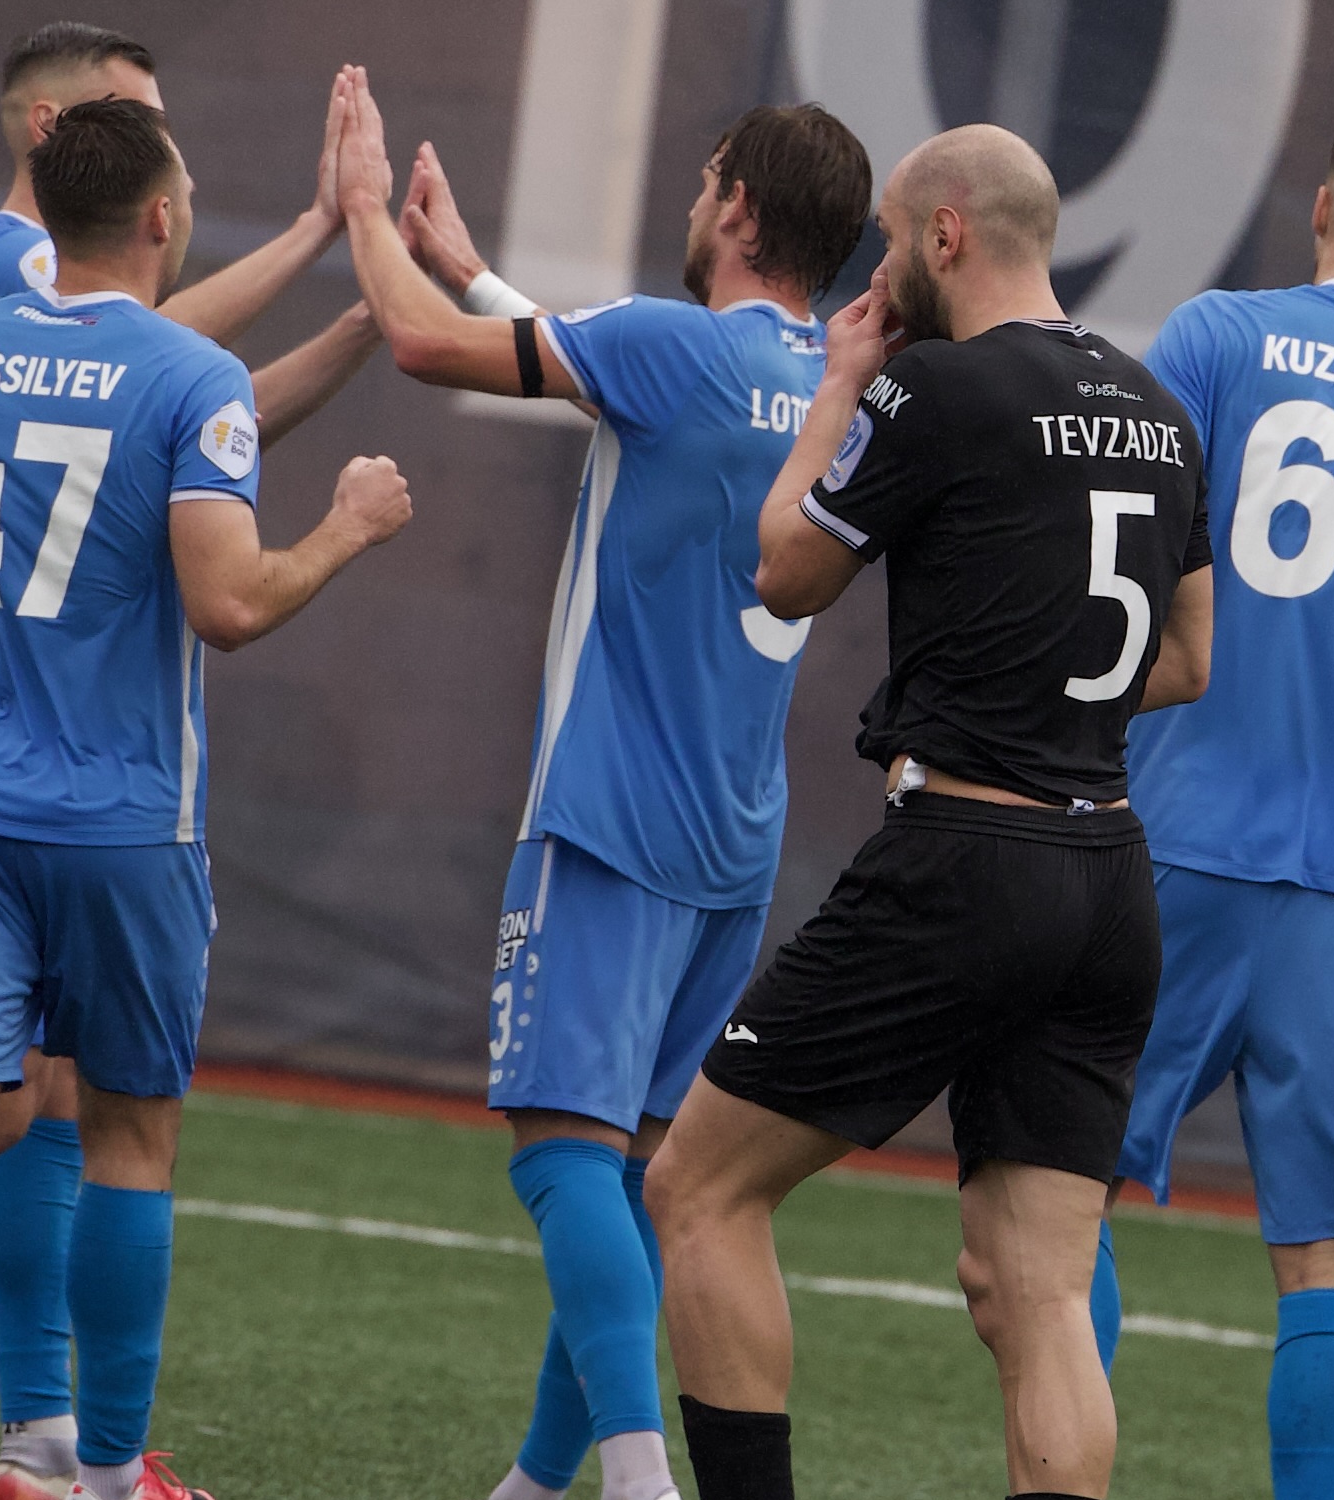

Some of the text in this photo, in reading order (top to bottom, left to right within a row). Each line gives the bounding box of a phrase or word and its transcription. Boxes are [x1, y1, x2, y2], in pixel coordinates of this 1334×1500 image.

[863, 374, 913, 420] ONX
[1095, 383, 1118, 391] LIFE
[1095, 388, 1144, 401] FOOTBALL
[1032, 414, 1185, 468] TEVZADZE
[1064, 489, 1156, 702] 5
